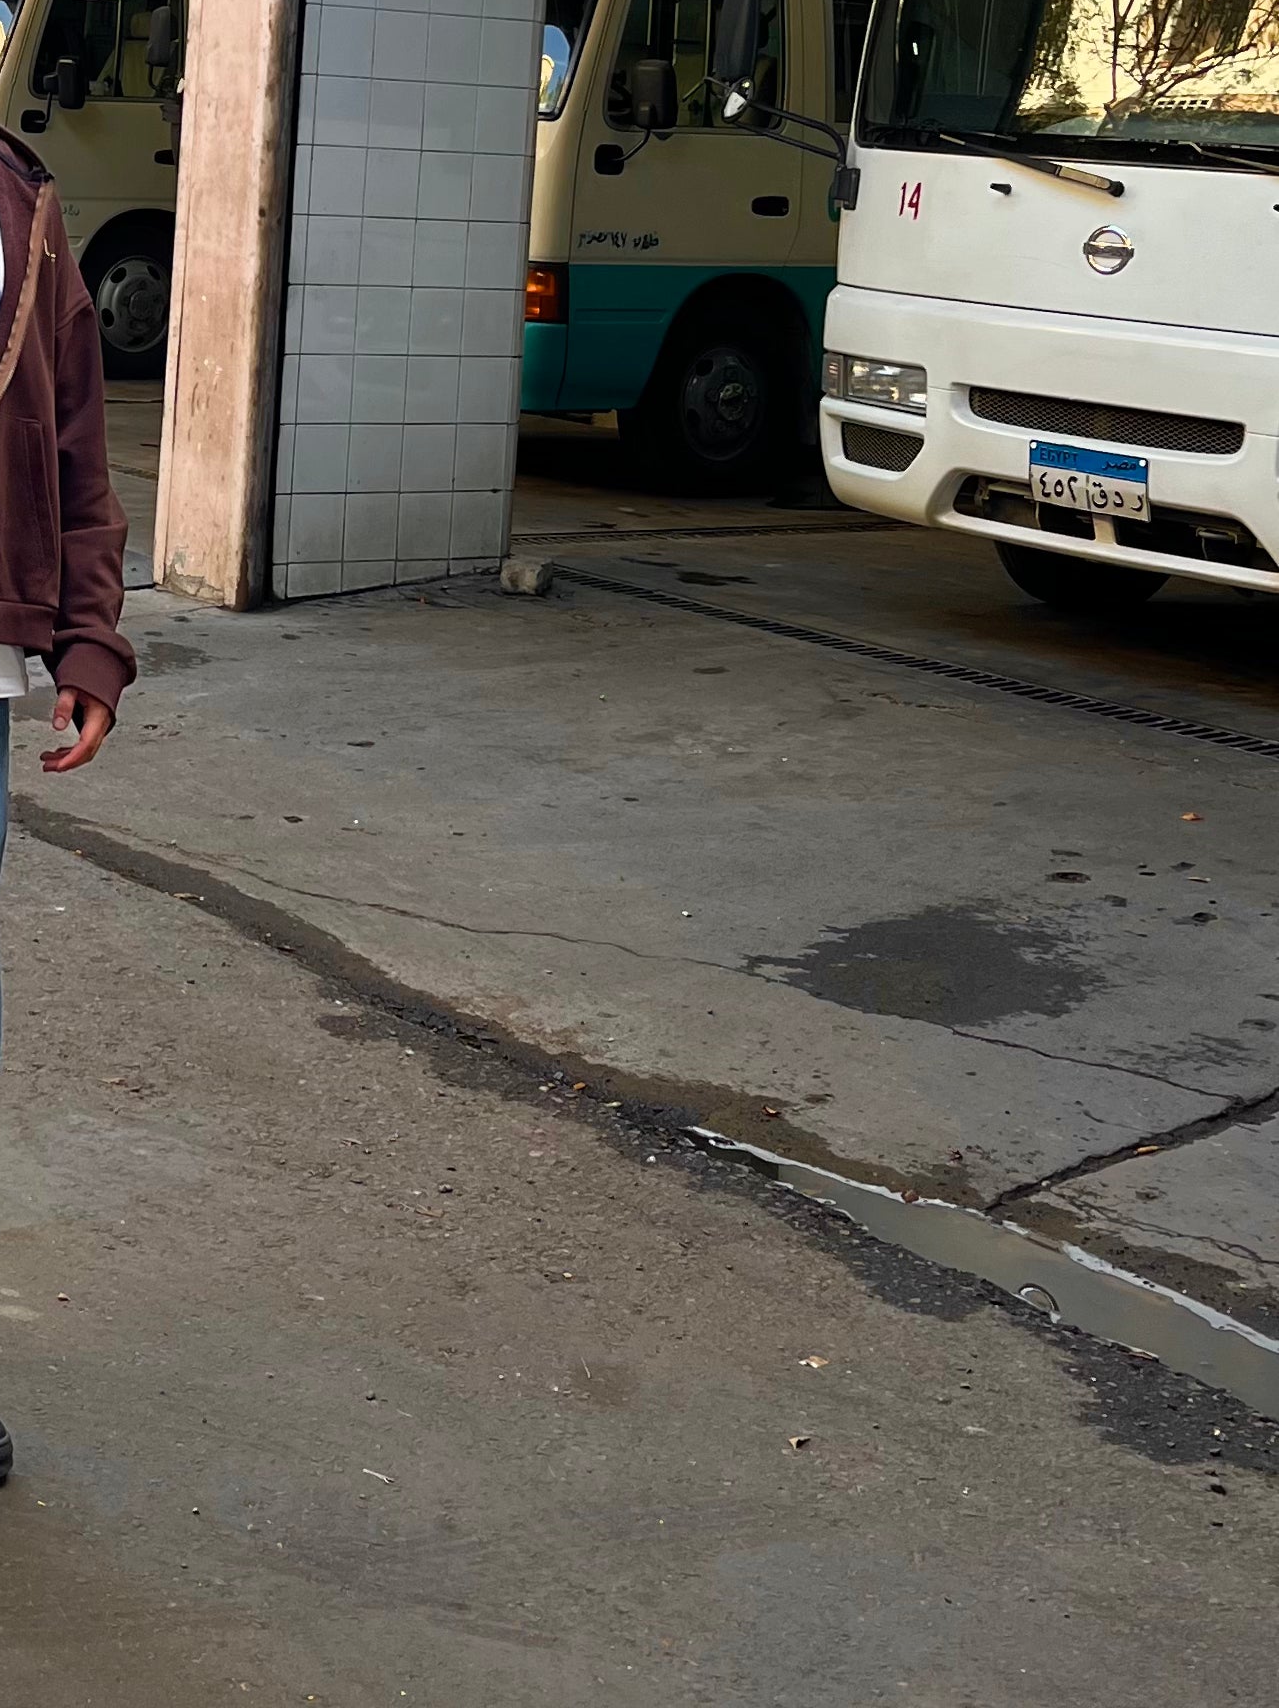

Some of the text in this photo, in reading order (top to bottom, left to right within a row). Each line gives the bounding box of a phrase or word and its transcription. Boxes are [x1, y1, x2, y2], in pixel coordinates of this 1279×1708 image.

[899, 181, 922, 221] 14
[1039, 446, 1079, 465] EGYPT
[1101, 459, 1138, 472] مصر
